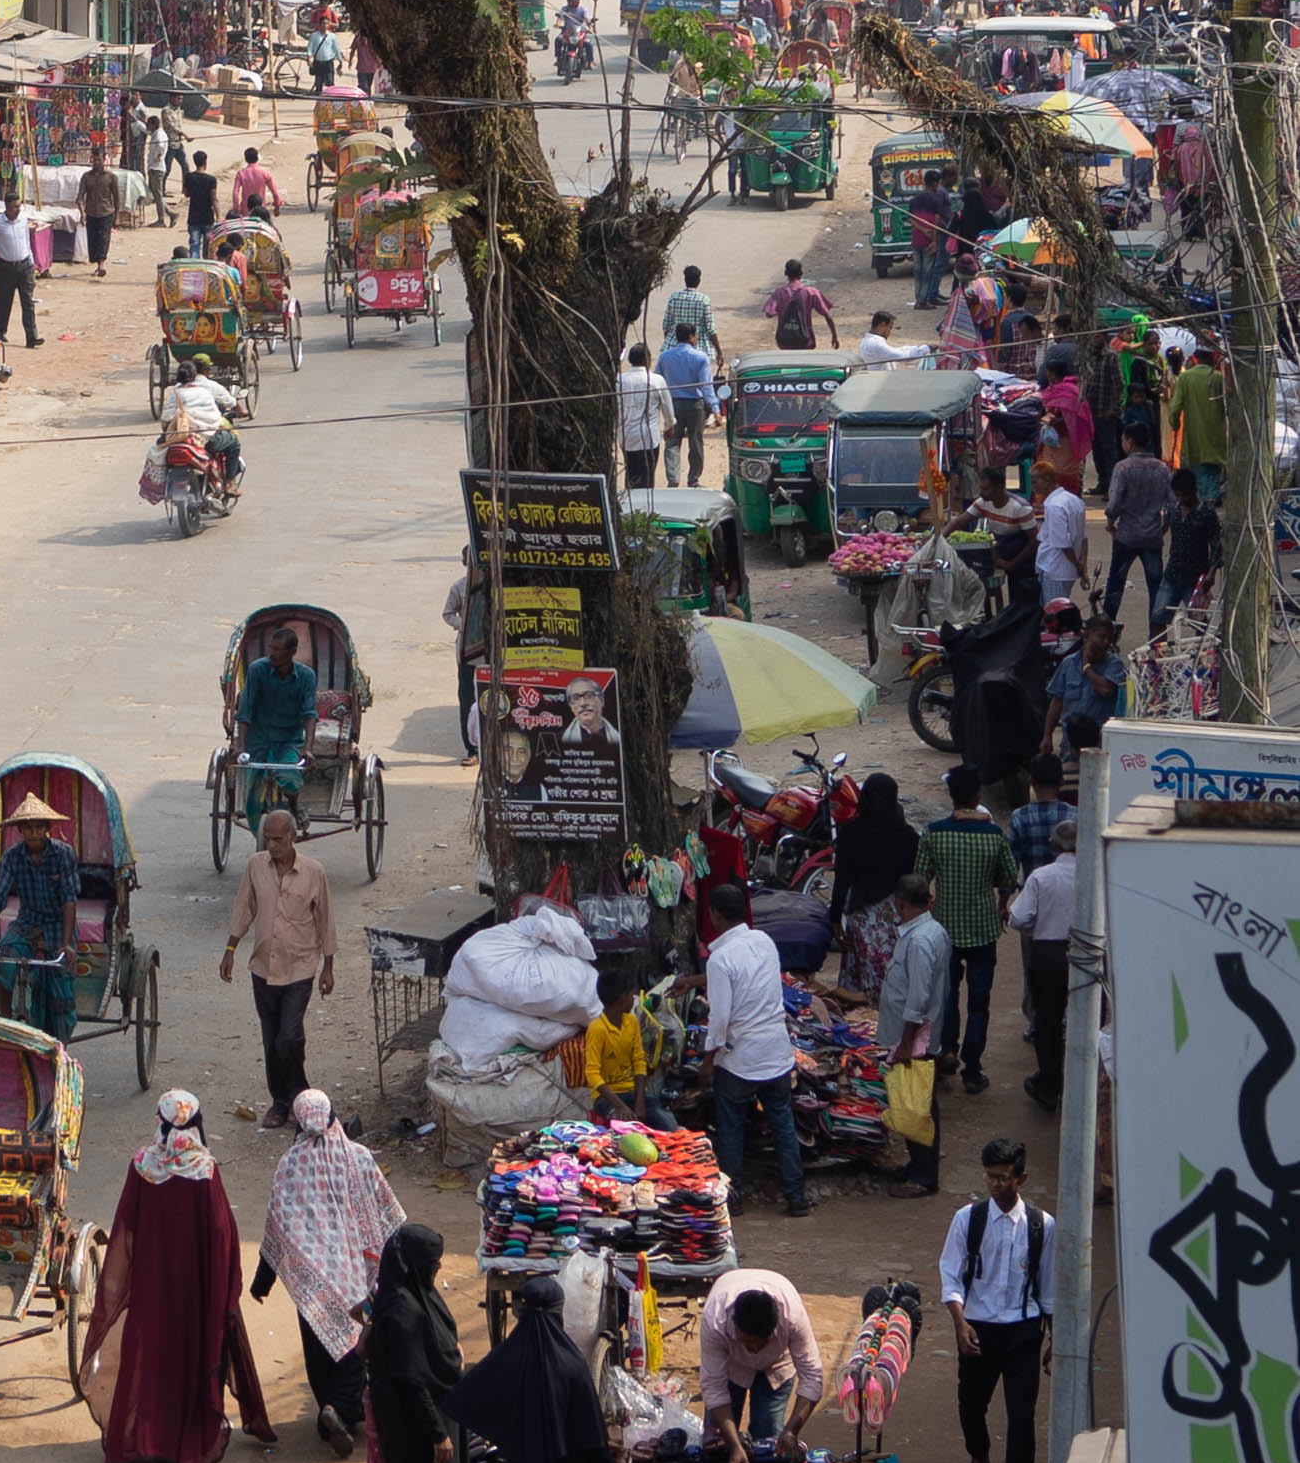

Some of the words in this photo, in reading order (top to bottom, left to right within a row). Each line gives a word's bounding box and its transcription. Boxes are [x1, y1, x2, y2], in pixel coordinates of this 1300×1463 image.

[763, 383, 819, 392] HIACE
[517, 501, 556, 528] তালাক
[518, 550, 586, 565] 01712-425
[587, 553, 612, 567] 435
[1120, 753, 1147, 771] নিউ
[1194, 880, 1288, 960] বাংলা
